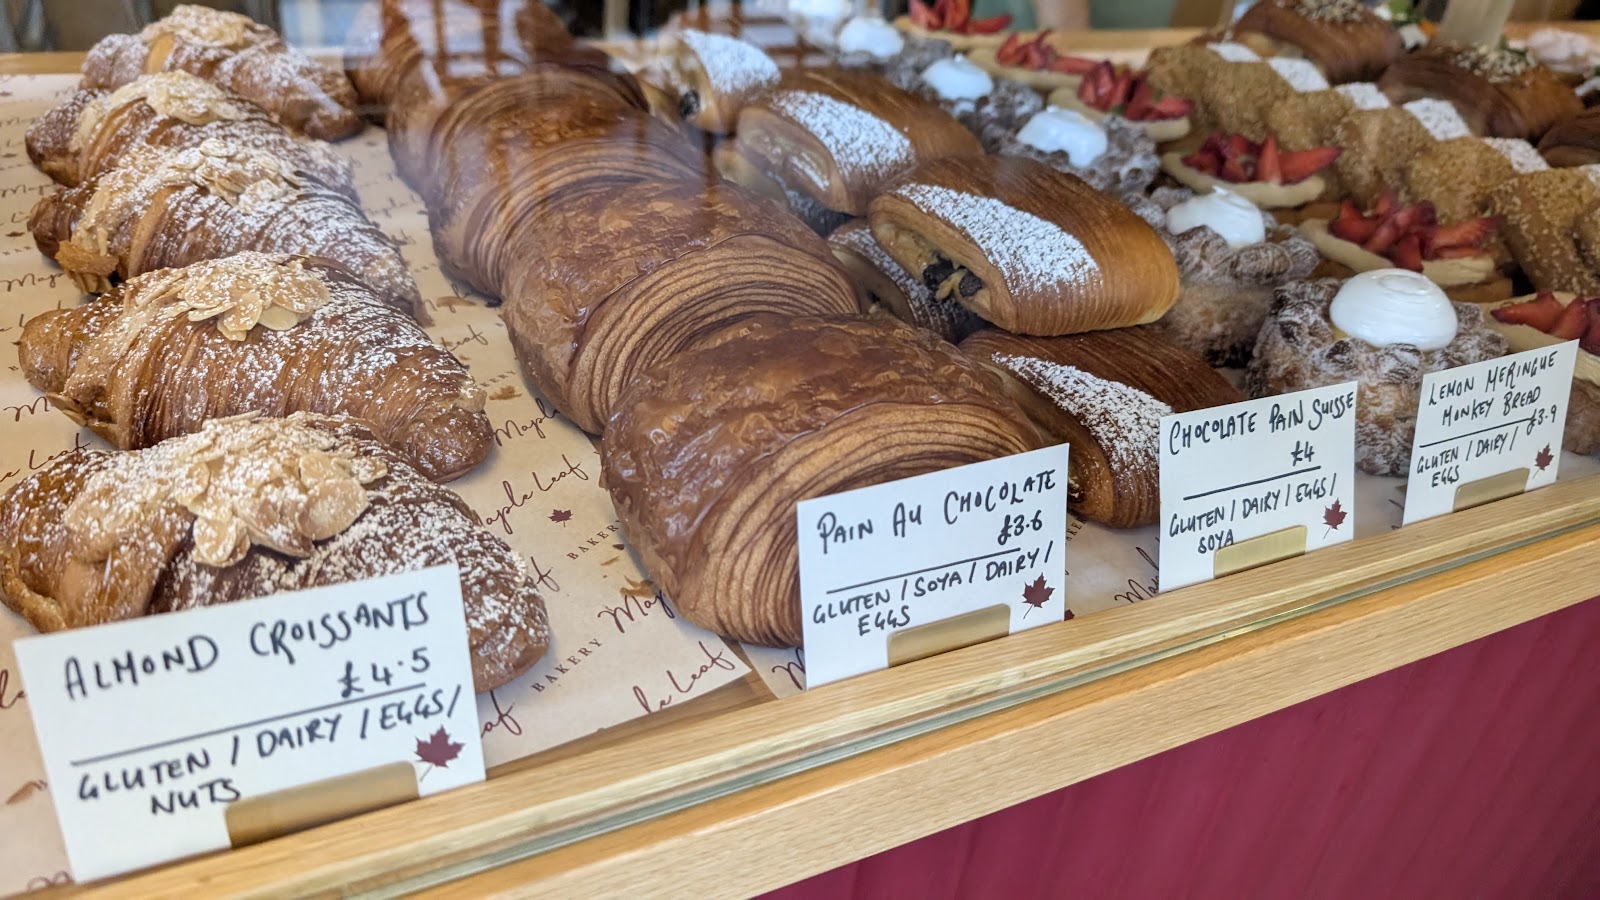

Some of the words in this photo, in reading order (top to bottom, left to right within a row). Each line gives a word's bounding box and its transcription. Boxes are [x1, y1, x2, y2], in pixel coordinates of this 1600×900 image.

[1428, 376, 1475, 406] LEMON
[1485, 350, 1559, 393] MERINGUE
[1169, 411, 1257, 455] CHOCOLATE
[1269, 399, 1304, 433] PAIN
[1308, 391, 1354, 431] SUISSE
[1442, 397, 1495, 427] MONKEY
[1502, 386, 1541, 416] BREAD
[1526, 404, 1557, 436] £3.9
[1290, 440, 1315, 467] £4
[1417, 446, 1459, 474] GLUTEN
[1475, 431, 1509, 459] DAIRY
[482, 480, 533, 534] aple
[532, 453, 588, 492] Leaf
[1431, 465, 1460, 488] EGGS
[817, 511, 874, 554] PAIN
[893, 502, 922, 538] AU
[943, 469, 1056, 525] CHOCOLATE
[997, 510, 1043, 546] £3.6
[1169, 506, 1225, 537] GLUTEN
[1242, 489, 1280, 519] DAIRY
[1296, 476, 1327, 503] EGGS
[566, 520, 621, 560] BAKER
[1198, 528, 1234, 554] SOYA
[813, 588, 891, 625] GLUTEN
[913, 571, 962, 597] SOYA
[985, 547, 1040, 582] DAIRY
[597, 590, 675, 634] Map
[858, 605, 911, 637] EGGS
[65, 634, 219, 700] ALMOND
[249, 591, 430, 665] CROISSANTS
[531, 638, 603, 693] BAKERY
[667, 641, 736, 693] Leaf
[77, 747, 211, 800] GLUTEN
[257, 712, 341, 758] DAIRY
[150, 778, 242, 817] NUTS
